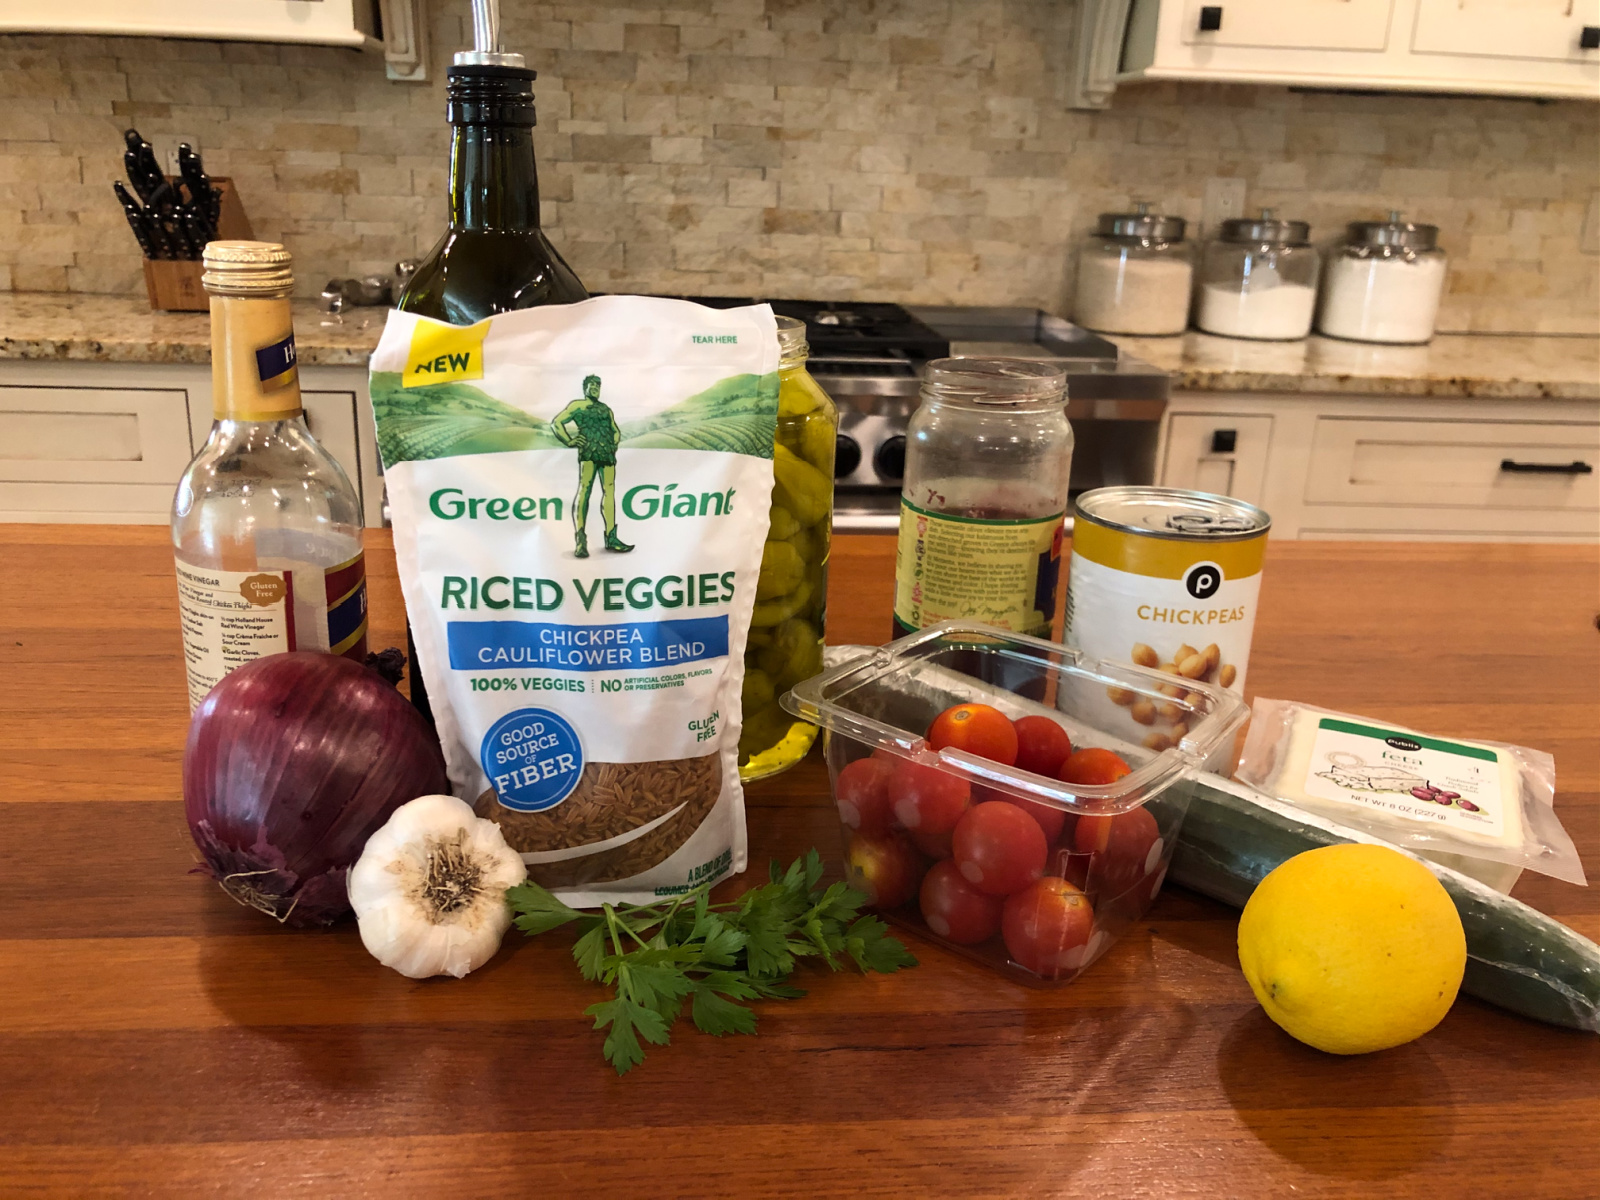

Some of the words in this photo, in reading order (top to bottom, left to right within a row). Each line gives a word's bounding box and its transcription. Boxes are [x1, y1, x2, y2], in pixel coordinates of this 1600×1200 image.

[692, 335, 714, 344] TEAR
[715, 335, 738, 344] HERE
[414, 352, 470, 374] NEW
[429, 488, 563, 521] Green
[621, 483, 736, 521] Giant
[193, 575, 220, 586] VINEGAR
[250, 582, 278, 590] Gluten
[256, 589, 274, 598] Free
[440, 575, 564, 612] RICED
[572, 571, 736, 613] VEGGIES
[233, 601, 252, 611] Thighs
[1137, 604, 1245, 626] CHICKPEAS
[540, 628, 644, 647] CHICKPEA
[477, 646, 632, 666] CAULIFLOWER
[639, 641, 706, 663] BLEND
[470, 678, 518, 692] 100%
[520, 678, 586, 693] VEGGIES
[624, 676, 659, 685] ARTIFICIAL
[660, 672, 688, 682] COLORS,
[687, 668, 713, 678] FLAVORS
[635, 680, 685, 691] PRESERVATIVES
[600, 679, 623, 693] NO
[500, 722, 545, 746] GOOD
[697, 725, 717, 743] FREE
[496, 733, 560, 764] SOURCE
[524, 754, 537, 764] OF
[1382, 751, 1423, 766] feta
[494, 753, 577, 795] FIBER
[1351, 794, 1370, 805] NET
[1398, 804, 1413, 814] OZ
[688, 868, 694, 882] A
[695, 859, 714, 881] BLEND
